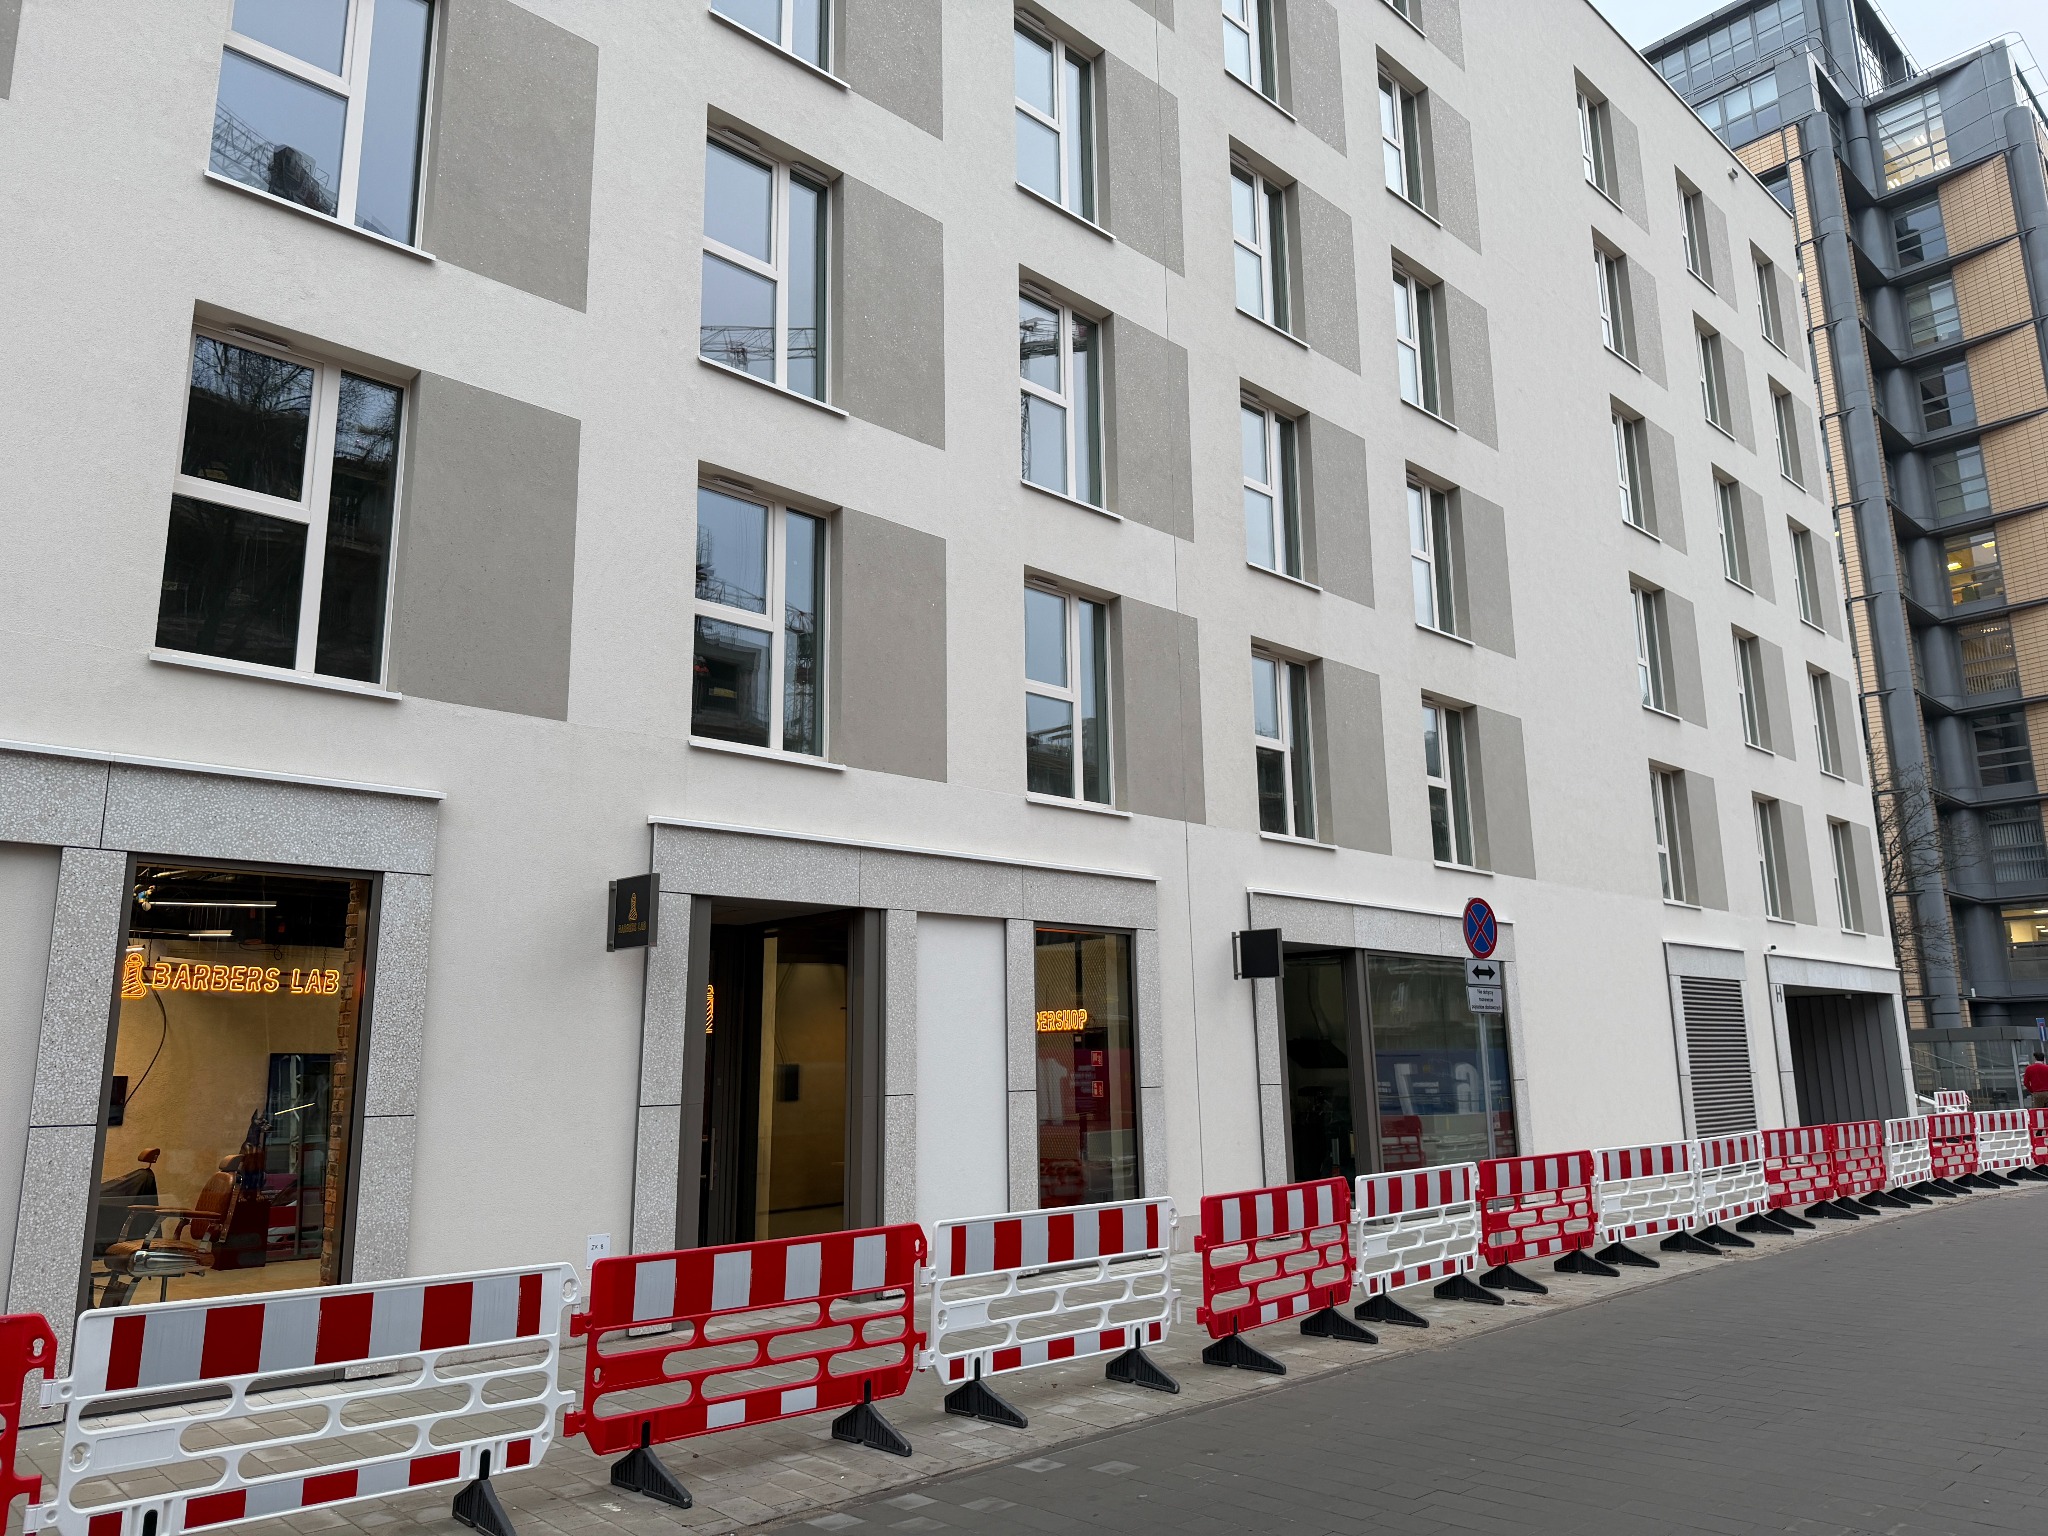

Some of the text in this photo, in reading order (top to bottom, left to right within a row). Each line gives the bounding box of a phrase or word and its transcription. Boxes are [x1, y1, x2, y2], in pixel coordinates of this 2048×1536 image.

[152, 962, 340, 994] BARBERS LAB
[1775, 985, 1783, 1003] H
